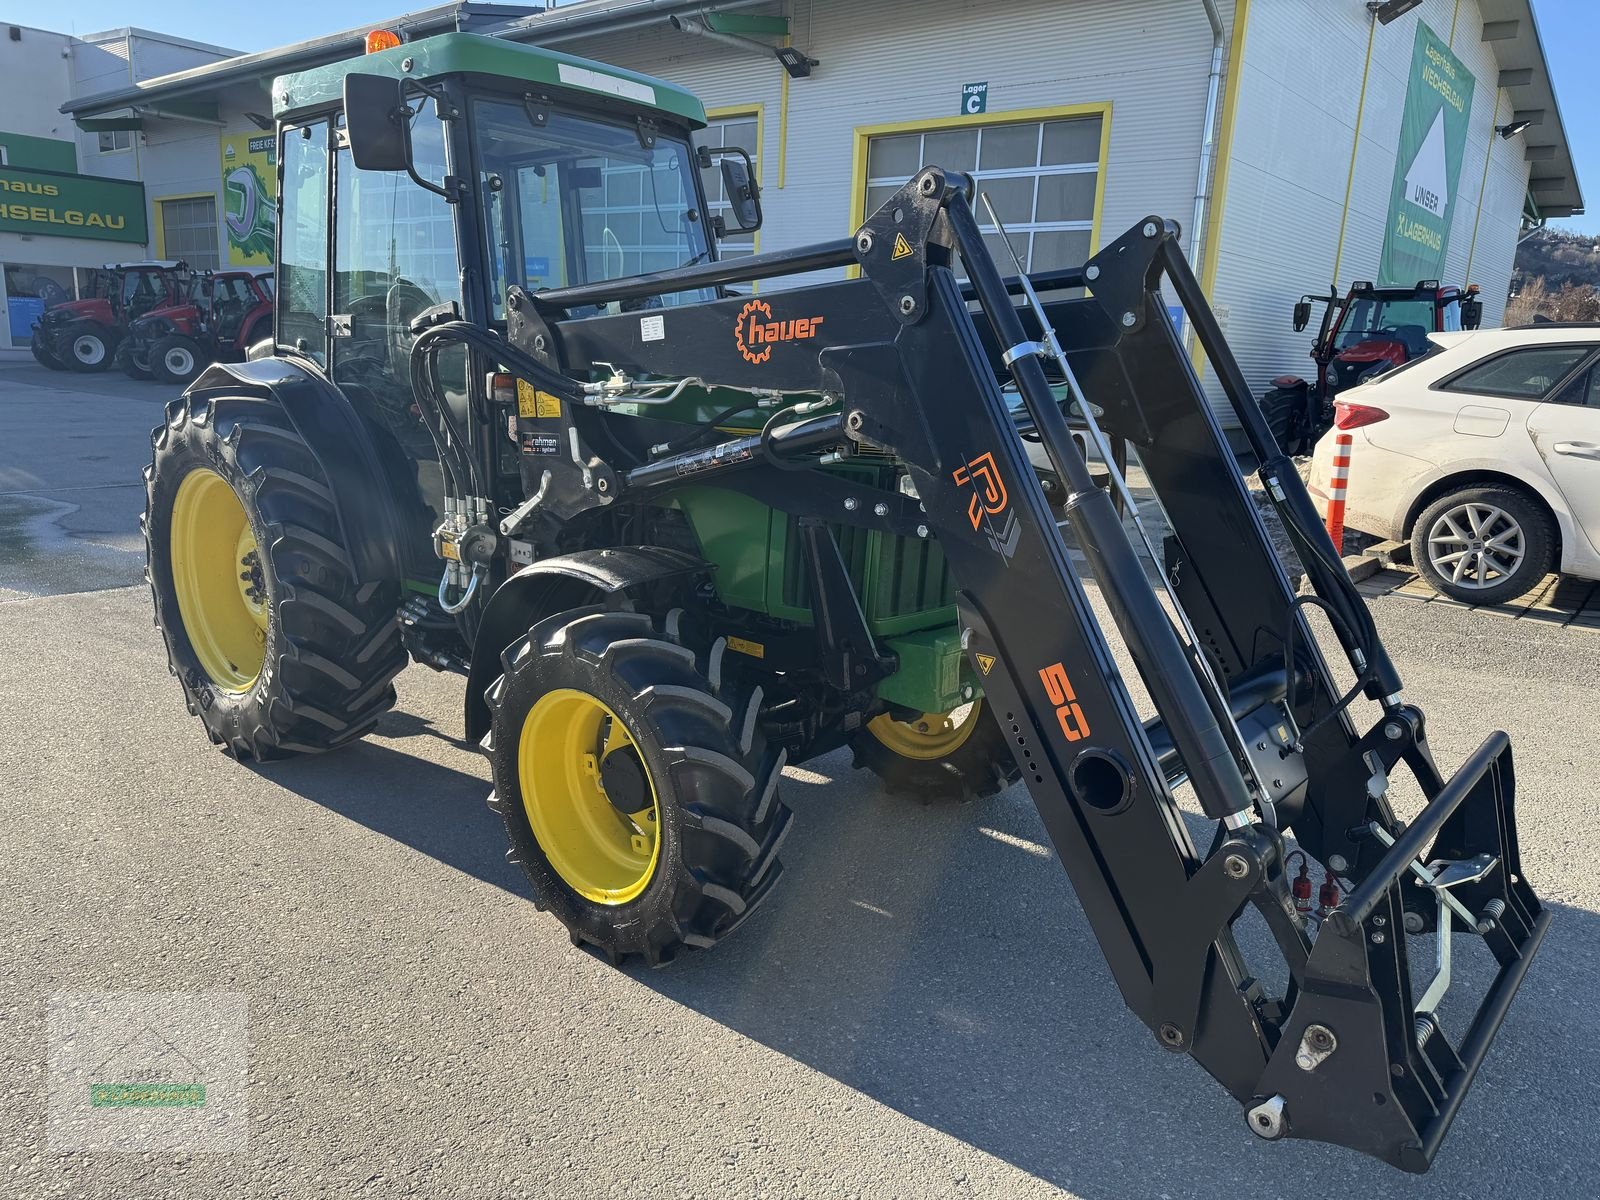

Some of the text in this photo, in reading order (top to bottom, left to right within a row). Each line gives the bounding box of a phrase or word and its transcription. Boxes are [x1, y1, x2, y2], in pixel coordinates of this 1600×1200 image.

[1425, 42, 1456, 80] Lagerhaus
[963, 84, 987, 94] Lager
[1422, 63, 1464, 113] WECHSELGAU
[966, 95, 980, 114] C
[250, 140, 264, 151] FREIE
[1414, 184, 1439, 212] UNSER
[748, 315, 824, 345] hauer
